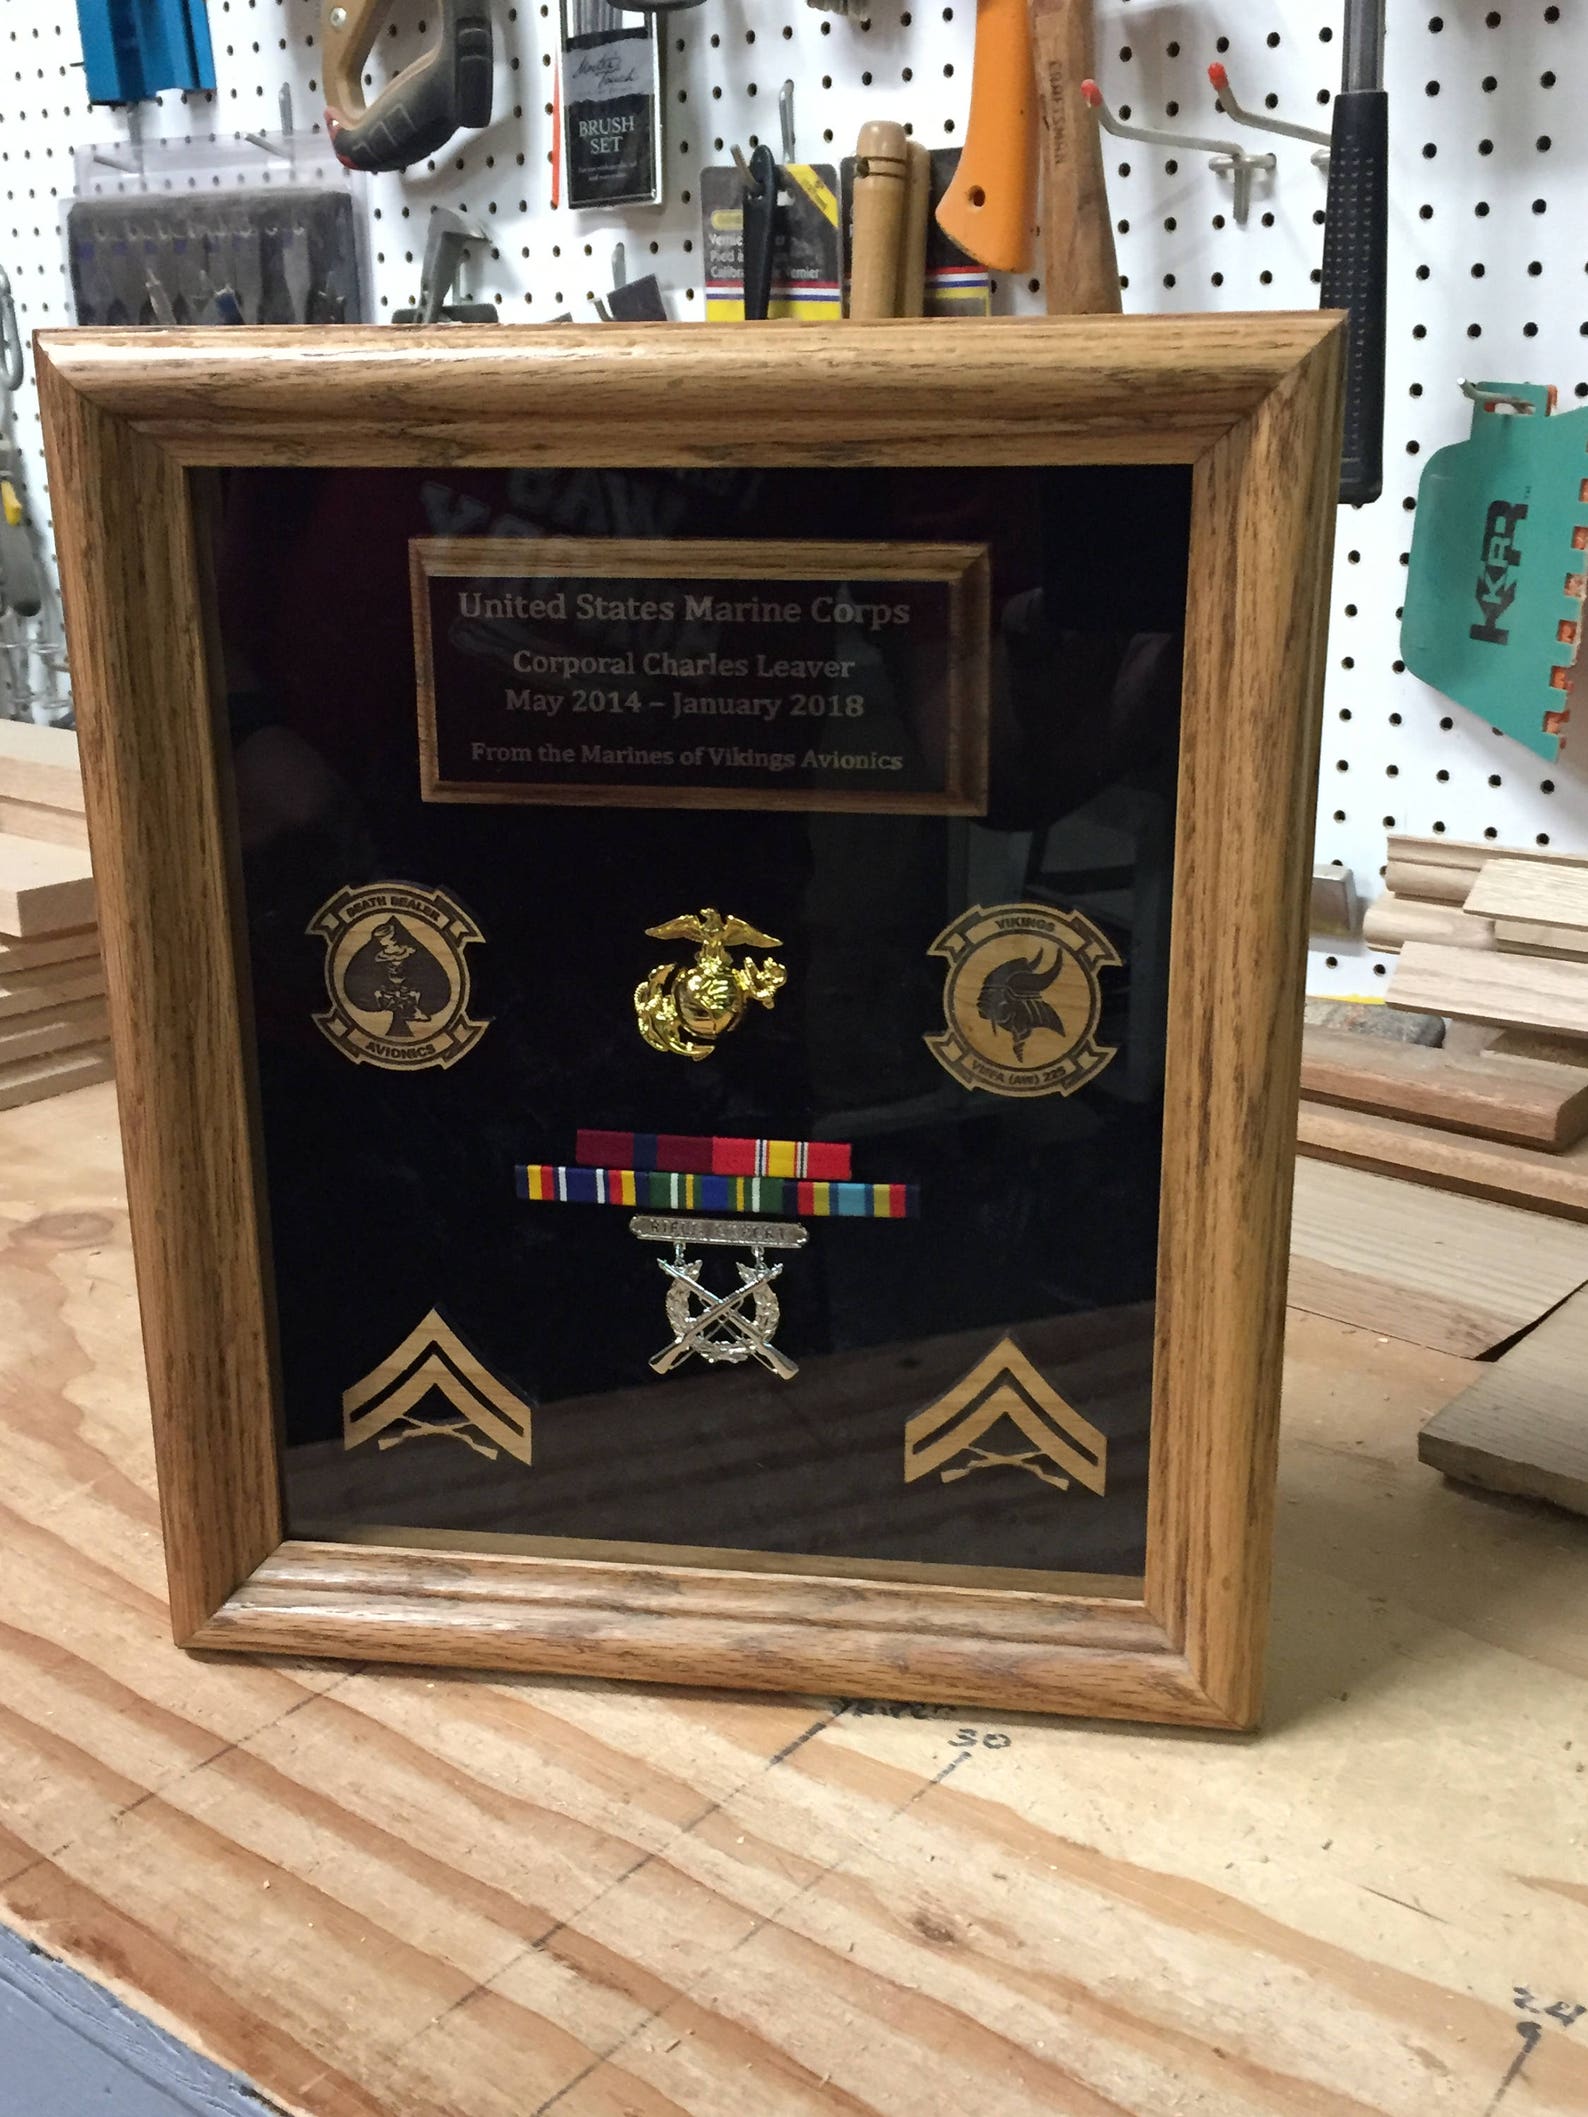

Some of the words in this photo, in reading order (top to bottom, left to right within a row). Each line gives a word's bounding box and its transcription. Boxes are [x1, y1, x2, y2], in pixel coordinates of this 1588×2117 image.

[1047, 60, 1067, 165] CRAFTSMAN
[579, 115, 635, 138] BRUSH
[590, 136, 624, 155] SET
[708, 232, 744, 247] Vernie
[785, 265, 820, 280] ernier
[458, 592, 567, 620] United
[576, 593, 675, 621] States
[684, 595, 802, 623] Marine
[811, 597, 910, 630] Corps
[513, 649, 636, 679] Corporal
[643, 652, 749, 678] Charles
[757, 654, 856, 680] Leaver
[504, 689, 564, 717] May
[572, 689, 642, 713] 2014
[673, 692, 782, 721] January
[790, 693, 864, 718] 2018
[471, 742, 532, 763] From
[538, 743, 575, 763] the
[581, 744, 674, 766] Marines
[680, 745, 706, 766] of
[708, 746, 795, 772] Vikings
[800, 749, 903, 771] Avionics
[346, 896, 387, 918] DEATH
[390, 896, 441, 922] DEALER
[994, 916, 1056, 932] VIKINGS
[364, 1041, 437, 1060] AVIONICS
[948, 1727, 1012, 1750] 30
